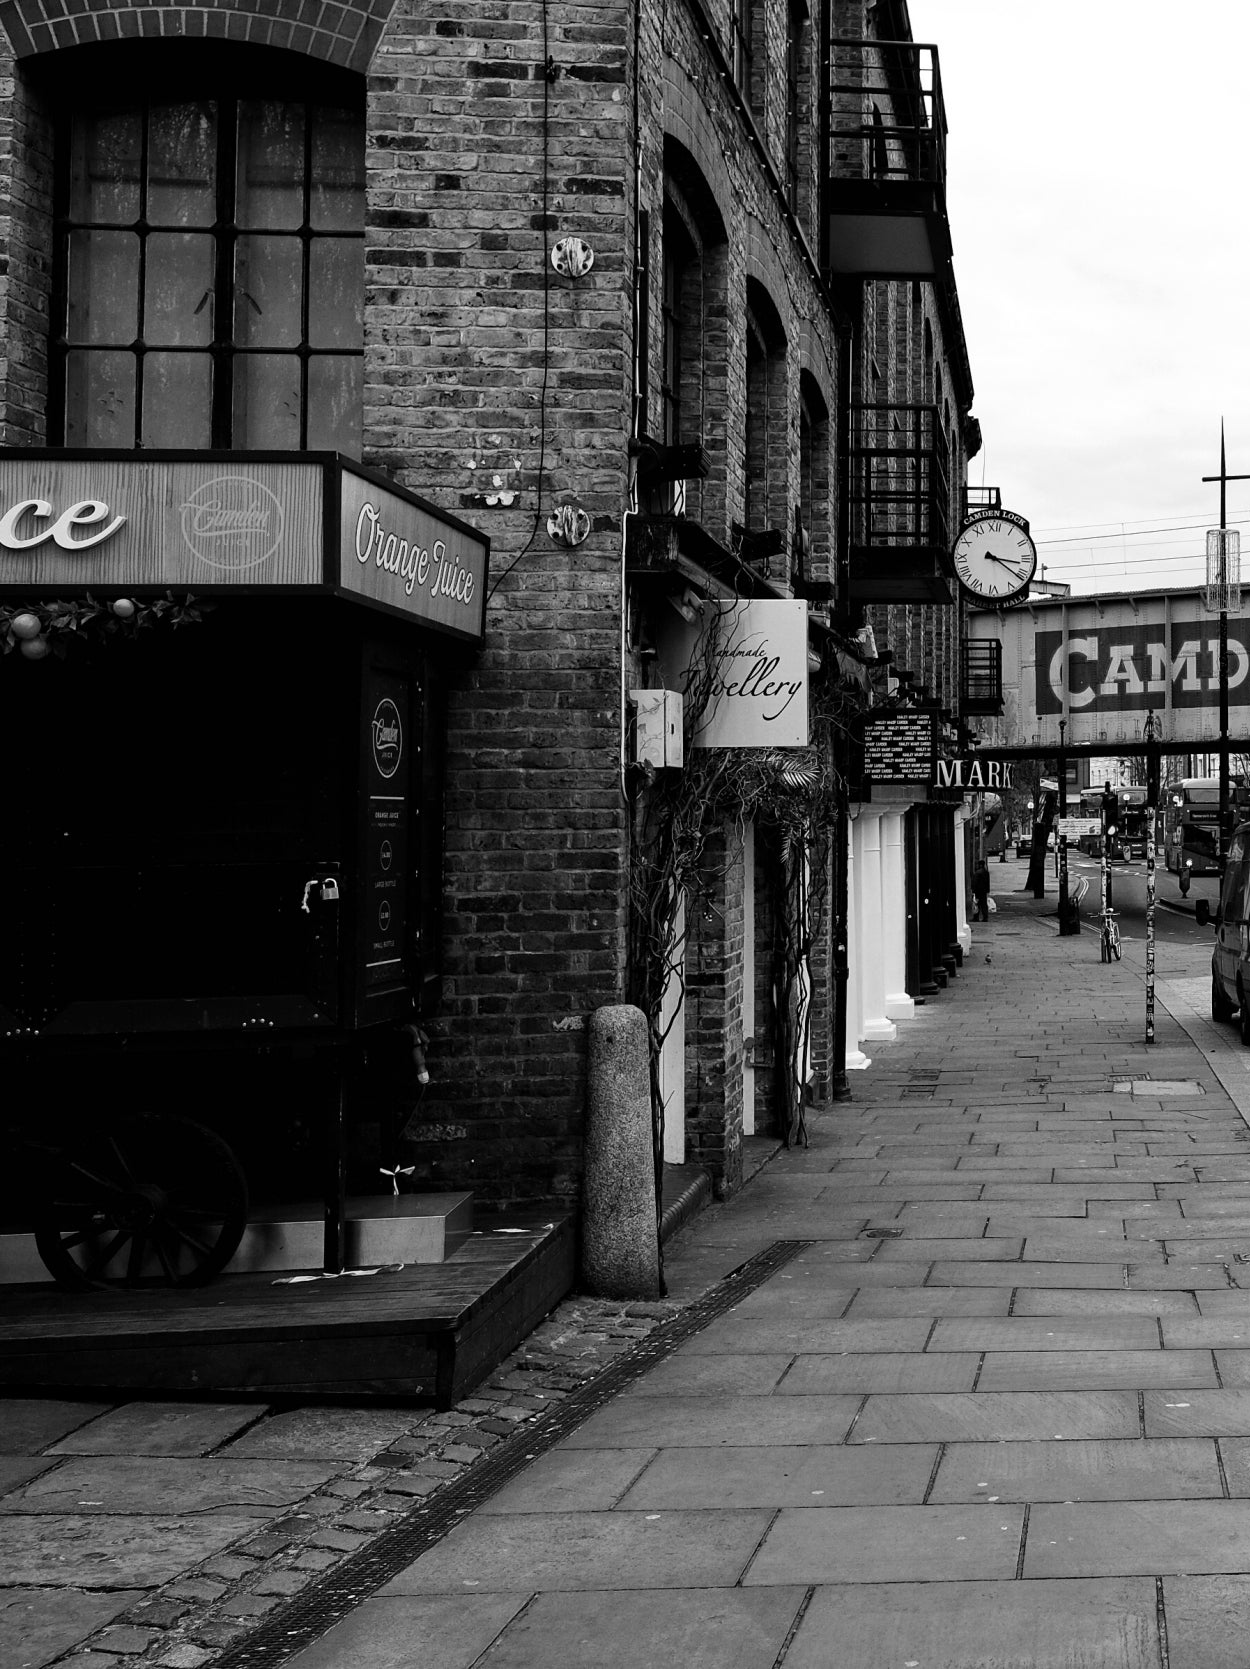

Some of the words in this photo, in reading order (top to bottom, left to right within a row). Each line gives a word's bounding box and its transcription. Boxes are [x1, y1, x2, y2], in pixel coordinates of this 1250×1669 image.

[963, 510, 1001, 525] CAMDEN
[1002, 511, 1026, 527] LOCK
[355, 501, 431, 597] Orange
[430, 539, 475, 606] Juice
